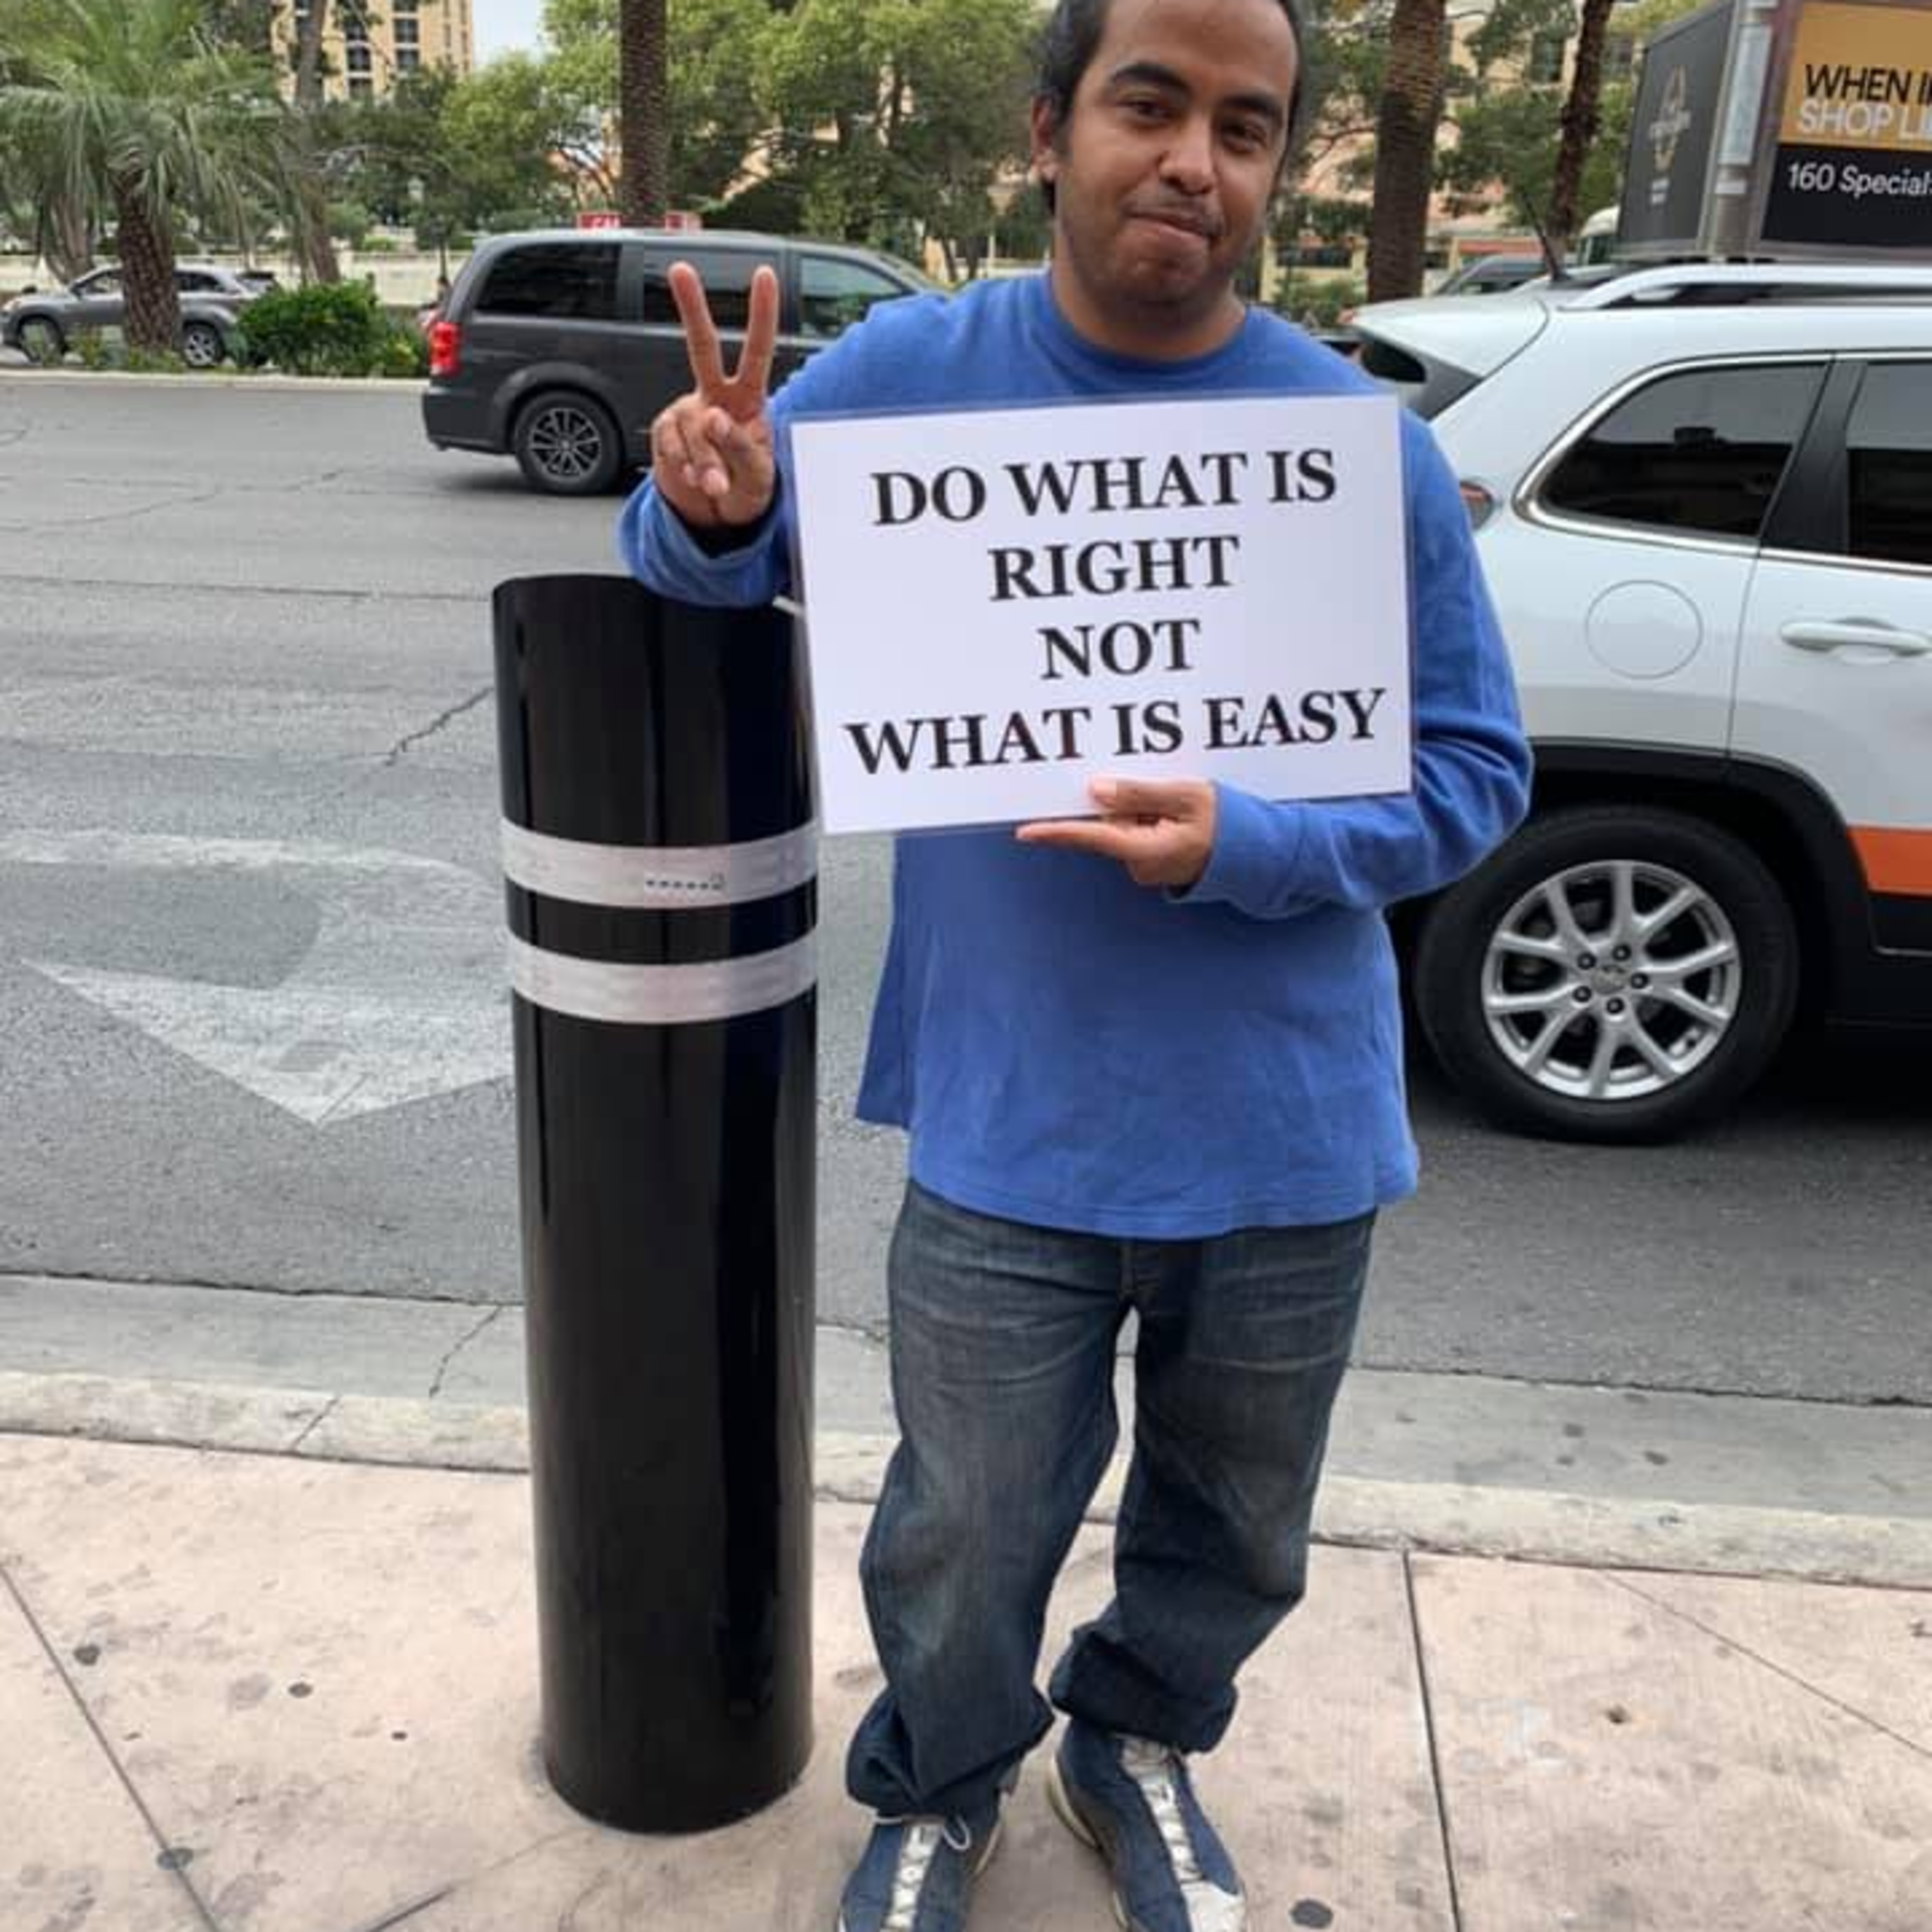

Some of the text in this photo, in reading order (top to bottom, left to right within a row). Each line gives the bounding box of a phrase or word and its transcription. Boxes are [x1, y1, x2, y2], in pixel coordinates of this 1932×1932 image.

[1805, 63, 1913, 105] WHEN
[1799, 99, 1894, 138] SHOP
[1788, 162, 1835, 192] 160
[872, 448, 1336, 526] DO WHAT IS
[989, 535, 1240, 600] RIGHT
[1039, 619, 1200, 679] NOT
[844, 688, 1387, 775] WHAT IS EASY
